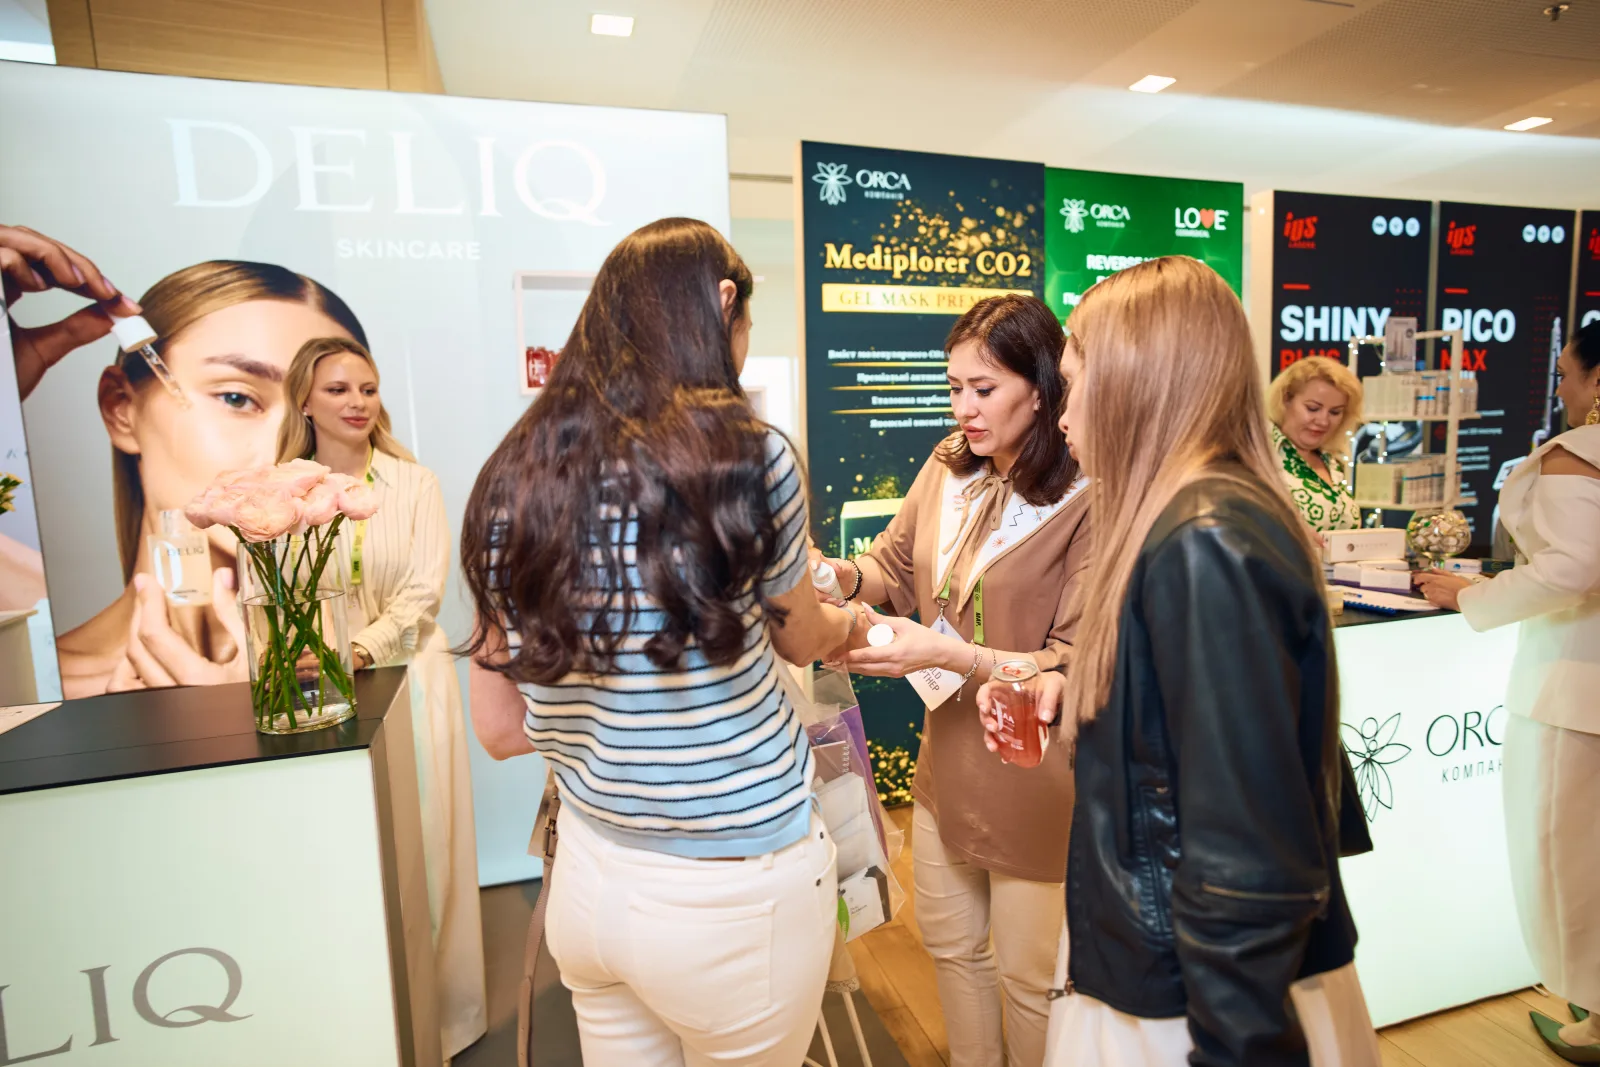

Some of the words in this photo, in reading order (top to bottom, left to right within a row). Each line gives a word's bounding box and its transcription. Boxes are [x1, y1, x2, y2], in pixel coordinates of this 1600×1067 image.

[165, 117, 611, 227] DELIQ
[855, 168, 912, 191] ORCA
[1090, 203, 1131, 221] ORCA
[336, 238, 481, 261] SKINCARE
[823, 242, 970, 279] Mediplorer
[975, 250, 1032, 277] CO2
[839, 290, 871, 306] GEL
[881, 291, 930, 308] MASK
[936, 293, 984, 308] PREM
[1280, 304, 1392, 343] SHINY
[1442, 308, 1516, 343] PICO
[1426, 704, 1504, 757] ORC
[1441, 759, 1503, 784] КОМПА
[0, 947, 255, 1067] LIQ
